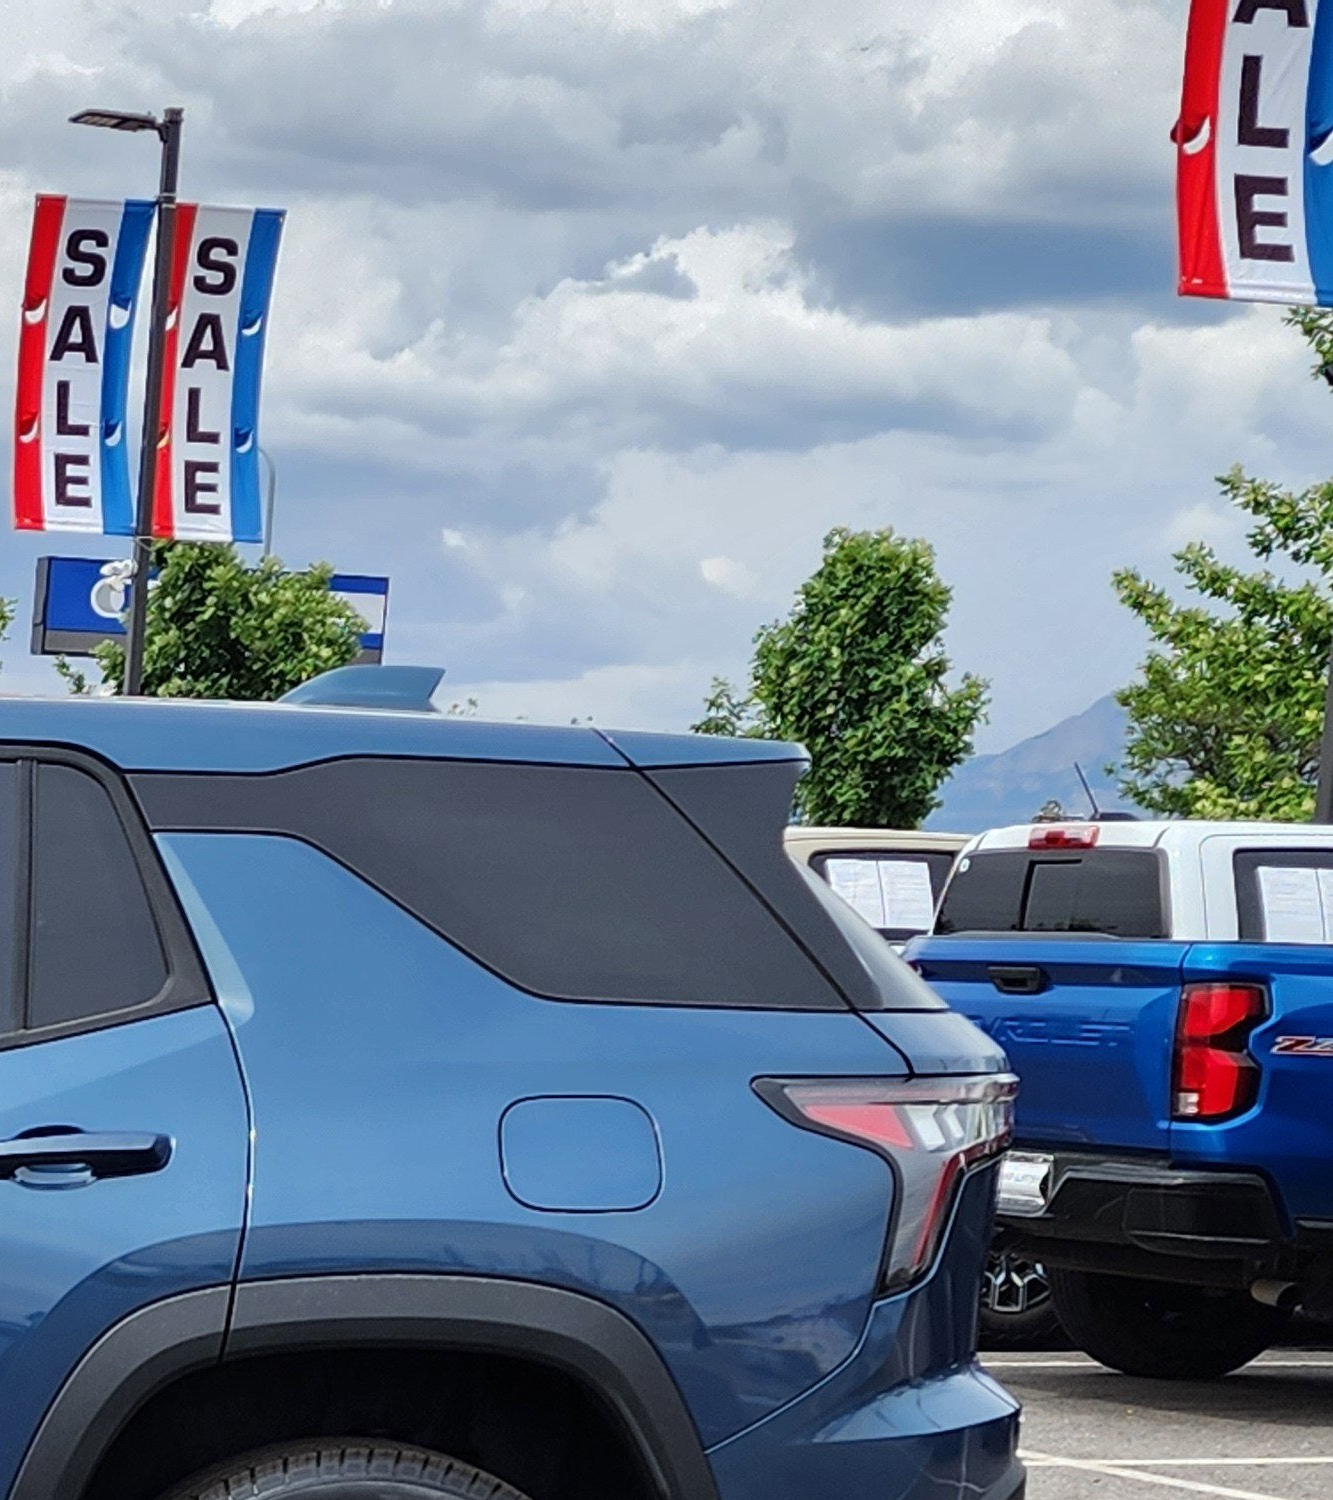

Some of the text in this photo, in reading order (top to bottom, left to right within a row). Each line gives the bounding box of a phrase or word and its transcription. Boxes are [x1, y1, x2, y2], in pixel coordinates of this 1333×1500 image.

[1233, 0, 1295, 262] LE
[49, 229, 110, 510] SALE
[180, 236, 239, 515] SALE
